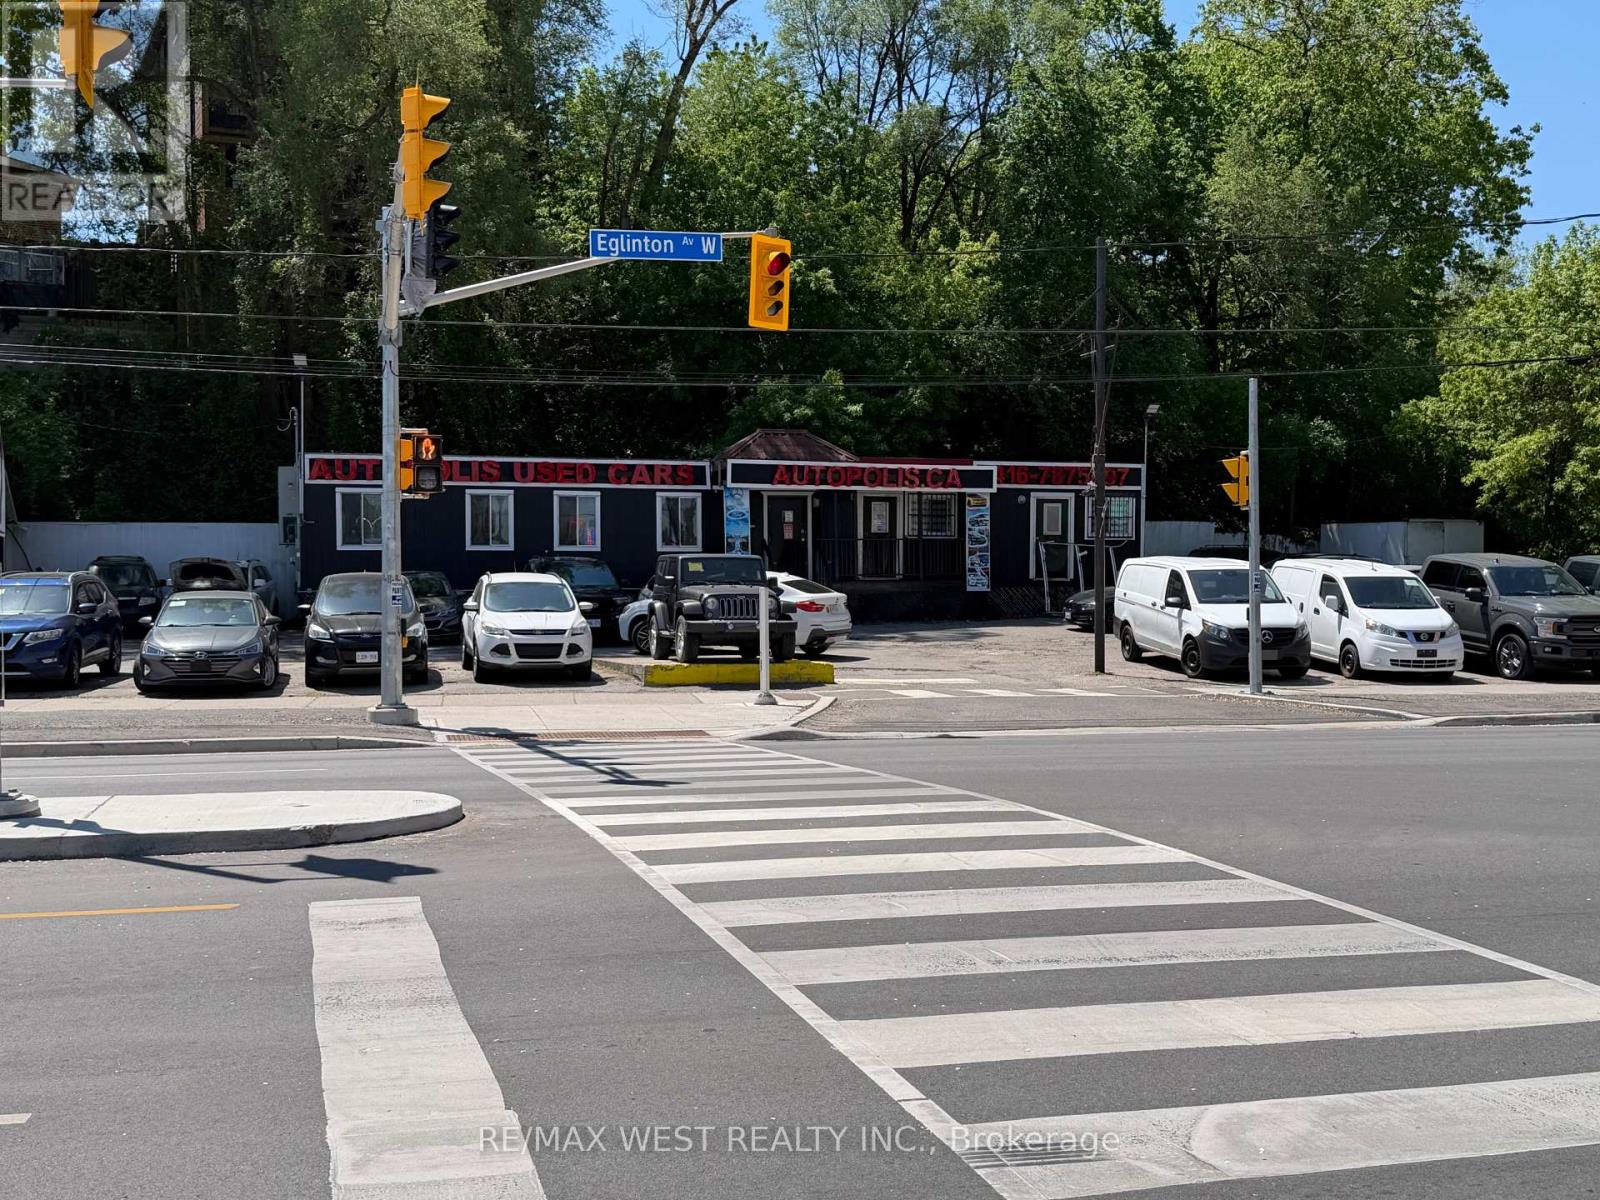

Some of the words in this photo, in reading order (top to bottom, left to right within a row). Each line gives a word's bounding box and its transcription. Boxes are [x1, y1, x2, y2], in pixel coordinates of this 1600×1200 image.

[597, 233, 674, 257] Eglinton
[682, 236, 694, 246] Av
[701, 236, 716, 255] W
[309, 457, 501, 482] AUTLIS
[513, 461, 596, 484] USED
[607, 463, 695, 486] CARS
[772, 464, 962, 489] AUTOPOLIS.CA
